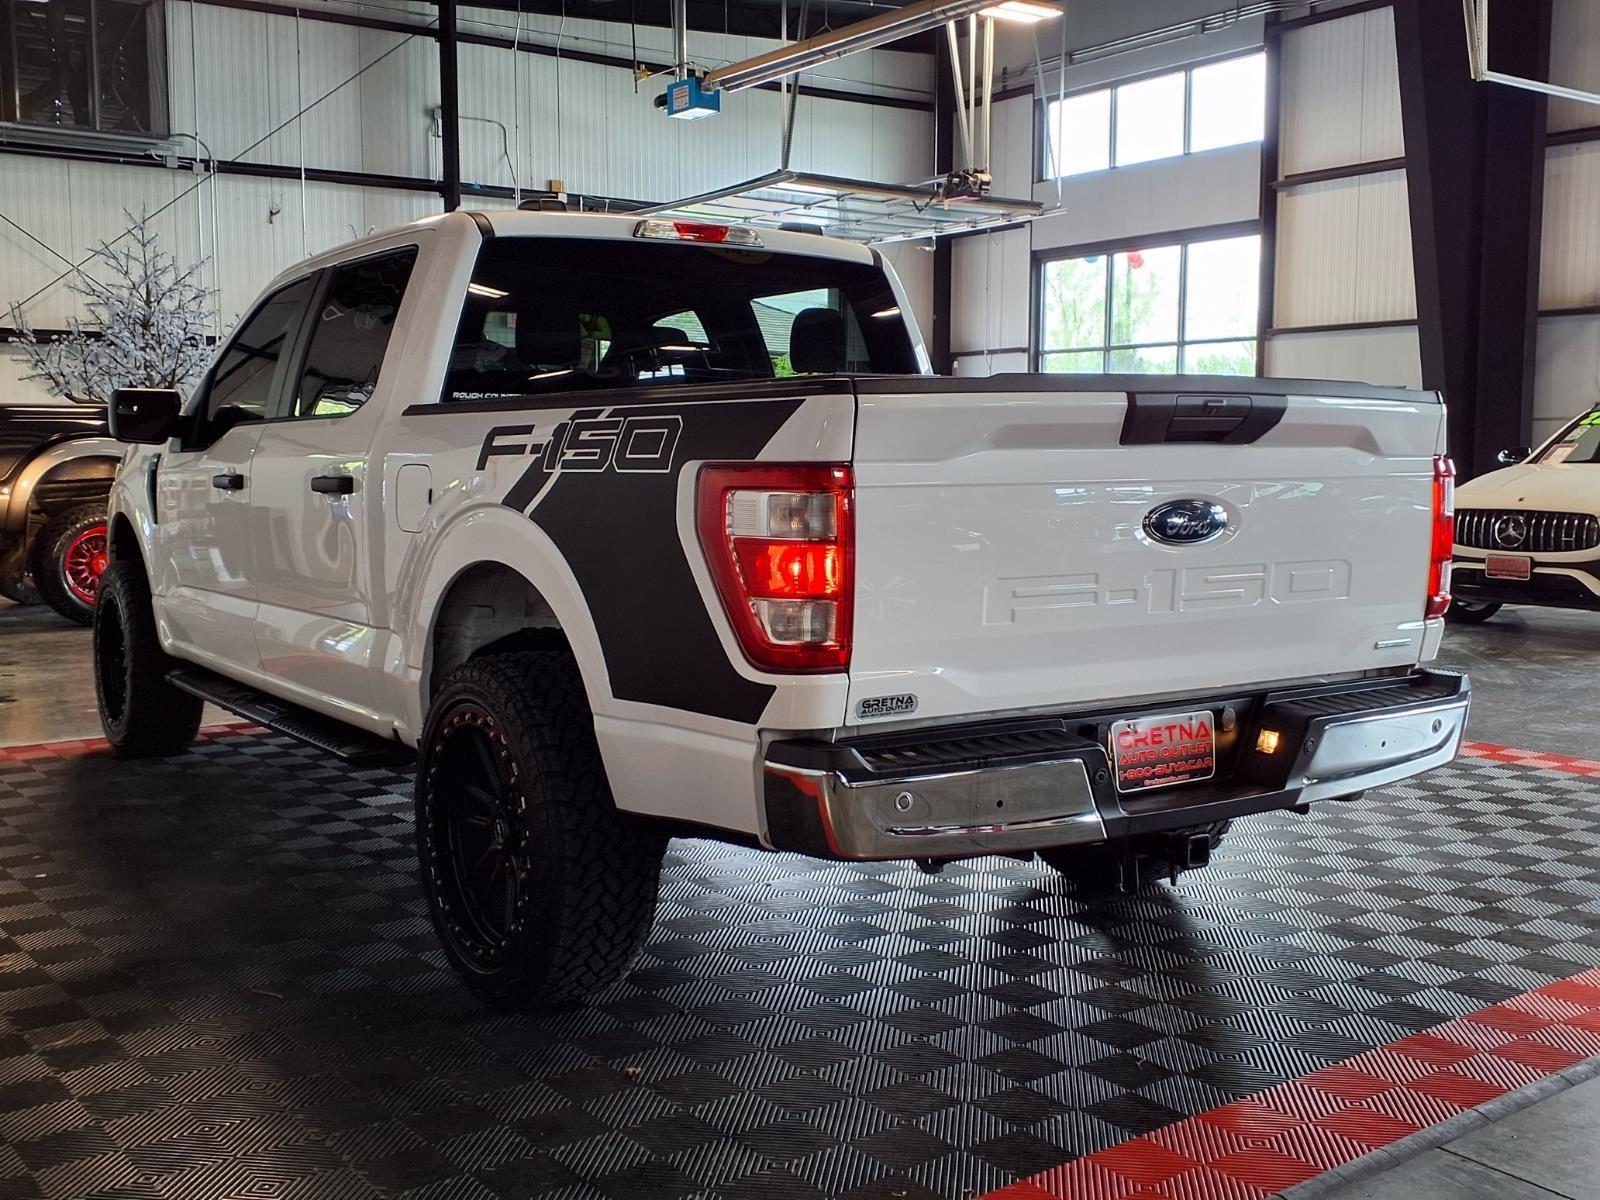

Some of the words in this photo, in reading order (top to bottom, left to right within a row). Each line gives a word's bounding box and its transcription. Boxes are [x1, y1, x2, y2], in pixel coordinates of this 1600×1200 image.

[452, 391, 484, 399] ROUGH
[475, 414, 684, 472] F-150
[1165, 509, 1212, 536] Ford
[982, 558, 1352, 627] F-150
[861, 695, 914, 709] GRETNA
[861, 707, 884, 715] AUTO
[885, 703, 914, 712] OUTLET
[1118, 720, 1211, 749] GRETNA
[1120, 751, 1156, 766] AUTO
[1161, 741, 1213, 759] OUTLET
[1120, 757, 1213, 780] 1-800-BUYACAR
